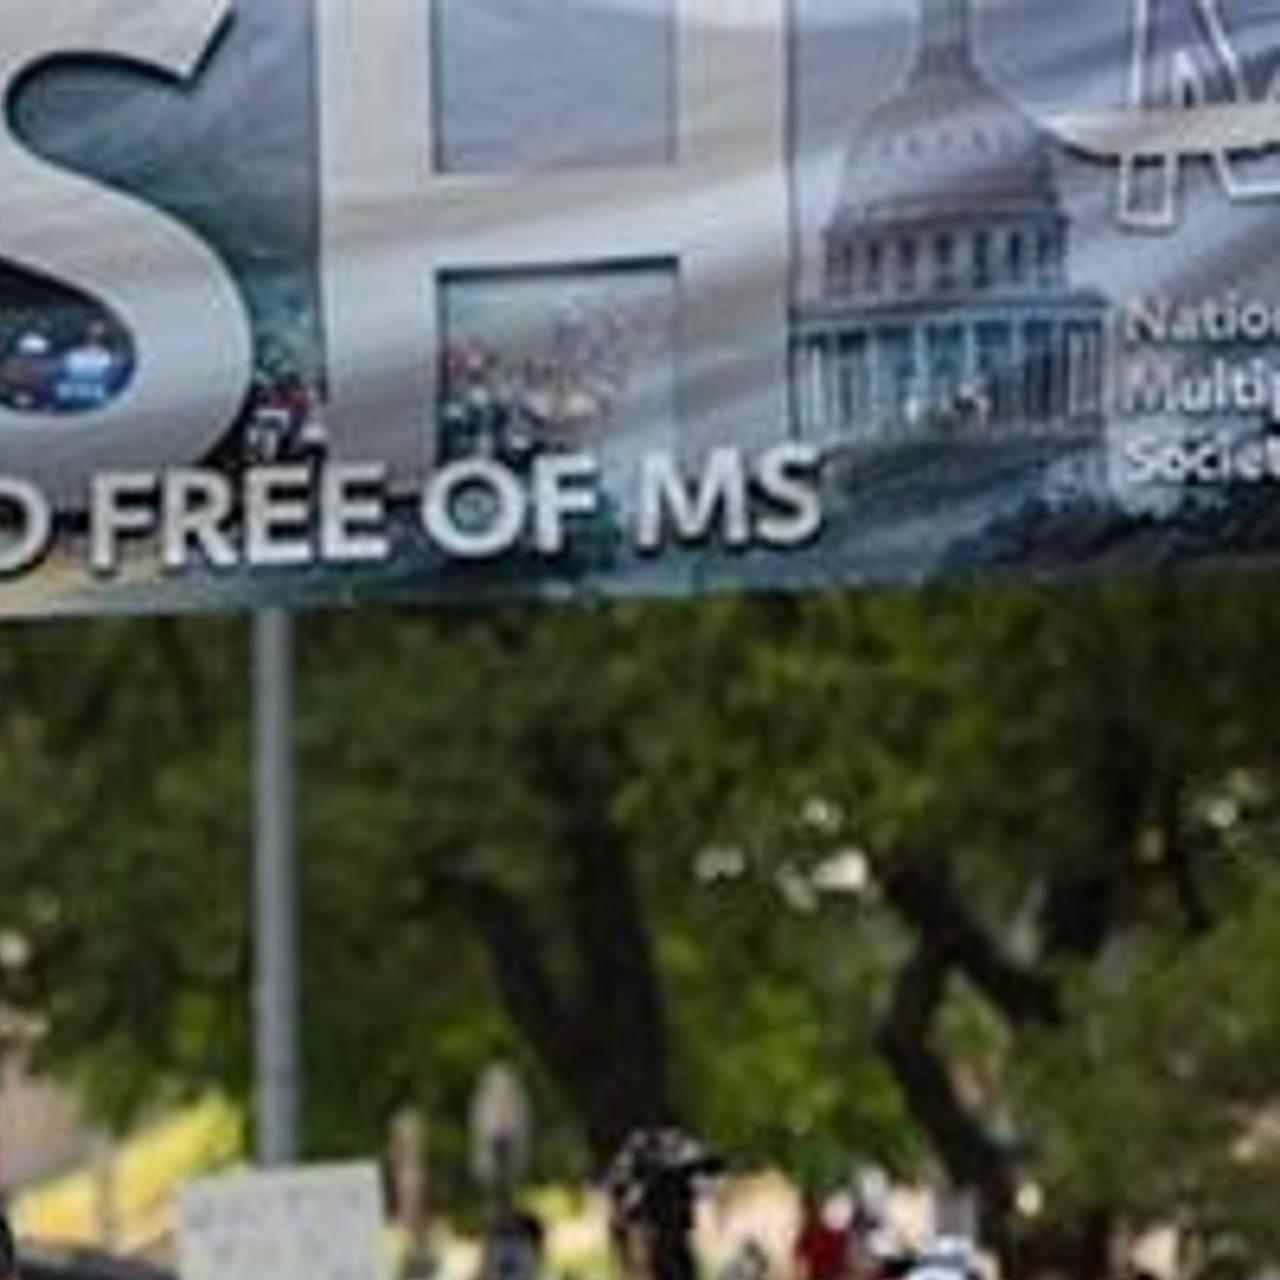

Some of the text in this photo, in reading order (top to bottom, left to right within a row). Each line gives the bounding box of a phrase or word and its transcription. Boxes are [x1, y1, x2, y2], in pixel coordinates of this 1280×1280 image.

[1124, 290, 1280, 342] Natio
[1126, 357, 1280, 423] Multi
[89, 460, 391, 568] FREE
[422, 450, 597, 558] OF
[638, 443, 826, 549] MS
